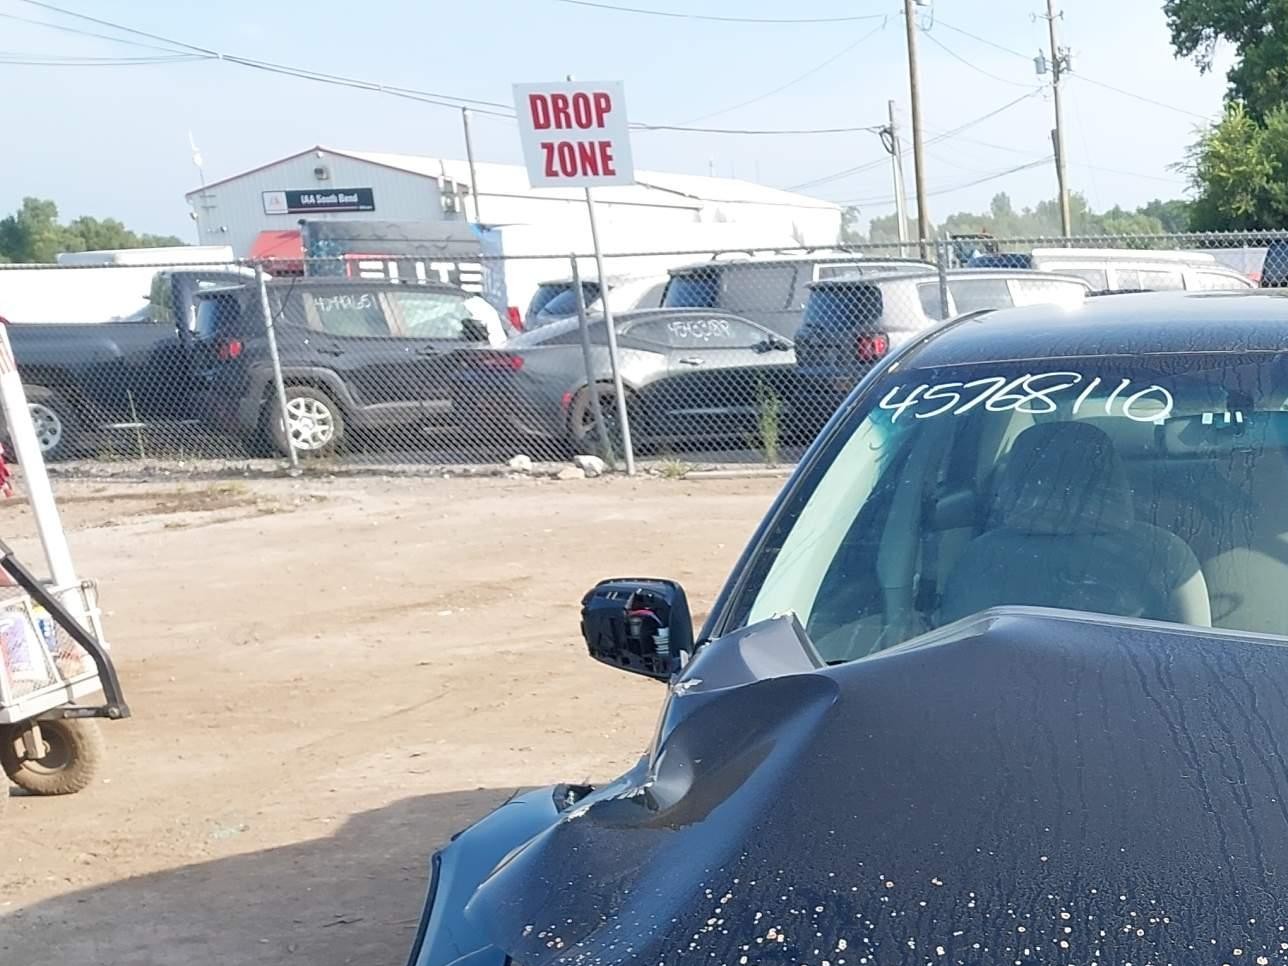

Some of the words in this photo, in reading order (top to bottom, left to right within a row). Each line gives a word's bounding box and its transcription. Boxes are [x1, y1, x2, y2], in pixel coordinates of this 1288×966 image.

[528, 92, 612, 130] DROP
[540, 141, 616, 177] ZONE
[338, 192, 358, 203] Bend
[879, 371, 1174, 424] 45768110
